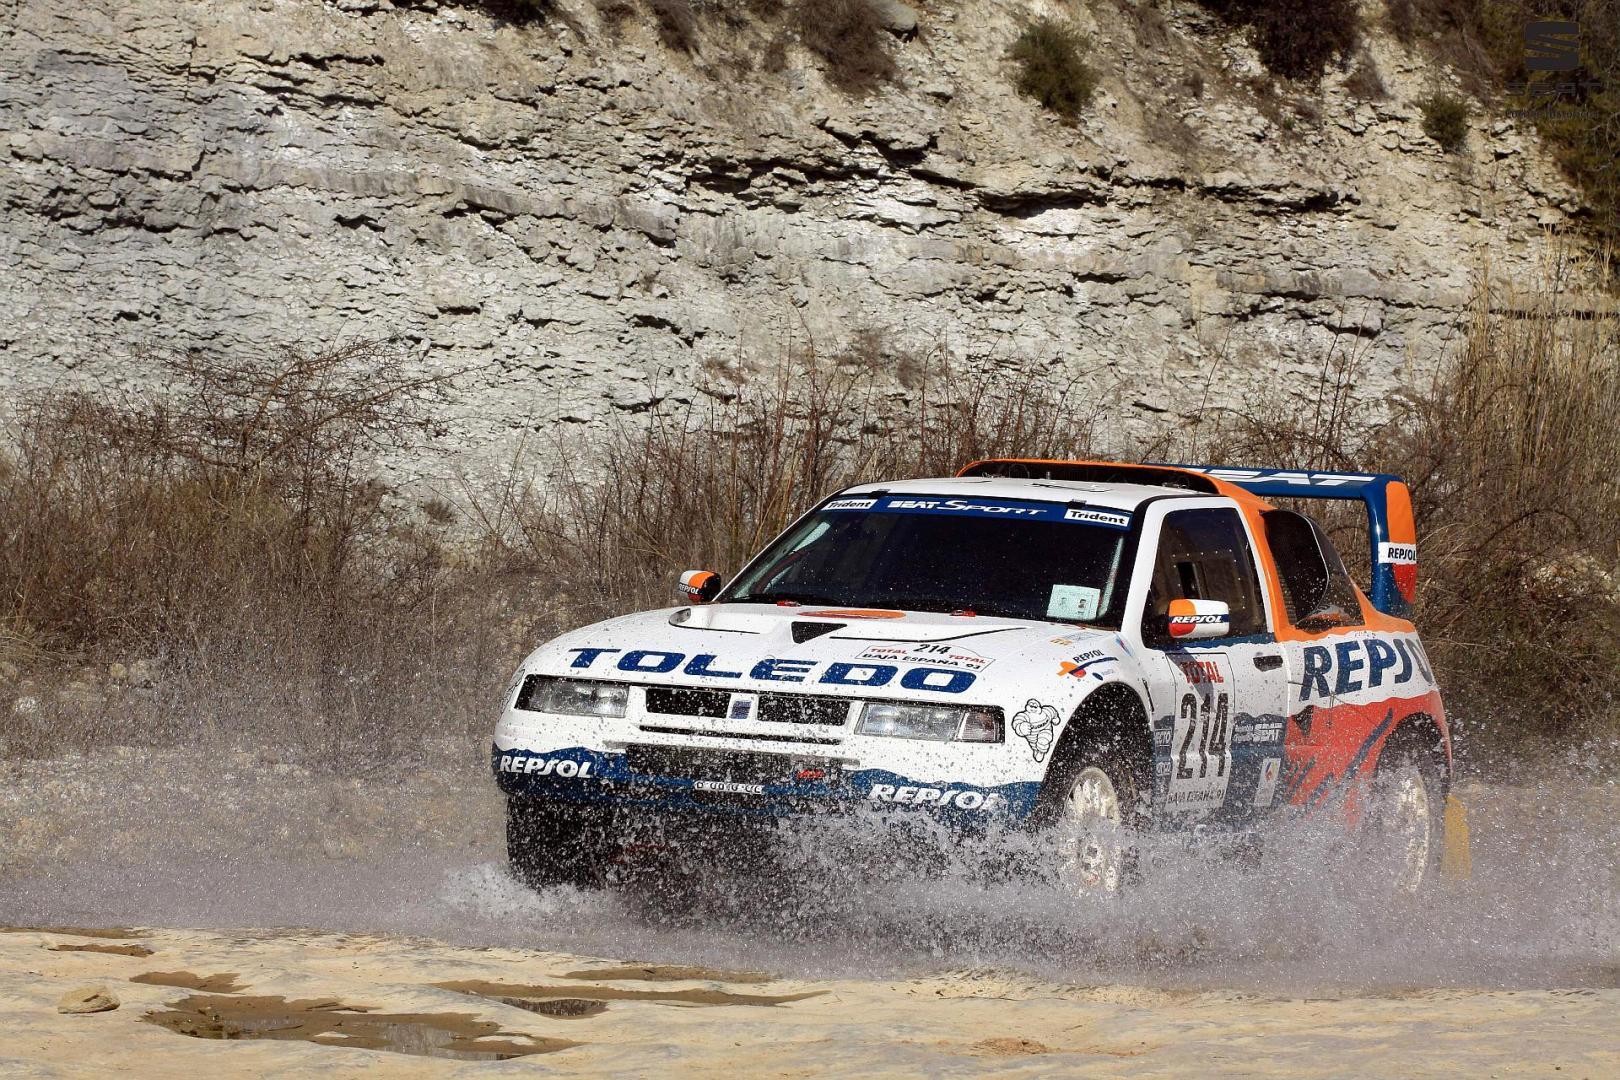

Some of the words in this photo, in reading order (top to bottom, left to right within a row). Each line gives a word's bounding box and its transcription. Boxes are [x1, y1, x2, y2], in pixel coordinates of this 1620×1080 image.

[828, 500, 872, 509] Trident
[1070, 510, 1126, 525] Trident
[1171, 615, 1223, 624] REPSOL
[913, 643, 952, 655] 214
[1072, 649, 1105, 664] REPSOL
[948, 654, 986, 664] TOTAL
[569, 648, 976, 693] TOLEDO
[1180, 661, 1224, 684] TOTAL
[1176, 693, 1228, 780] 214
[499, 755, 592, 778] REPSOL
